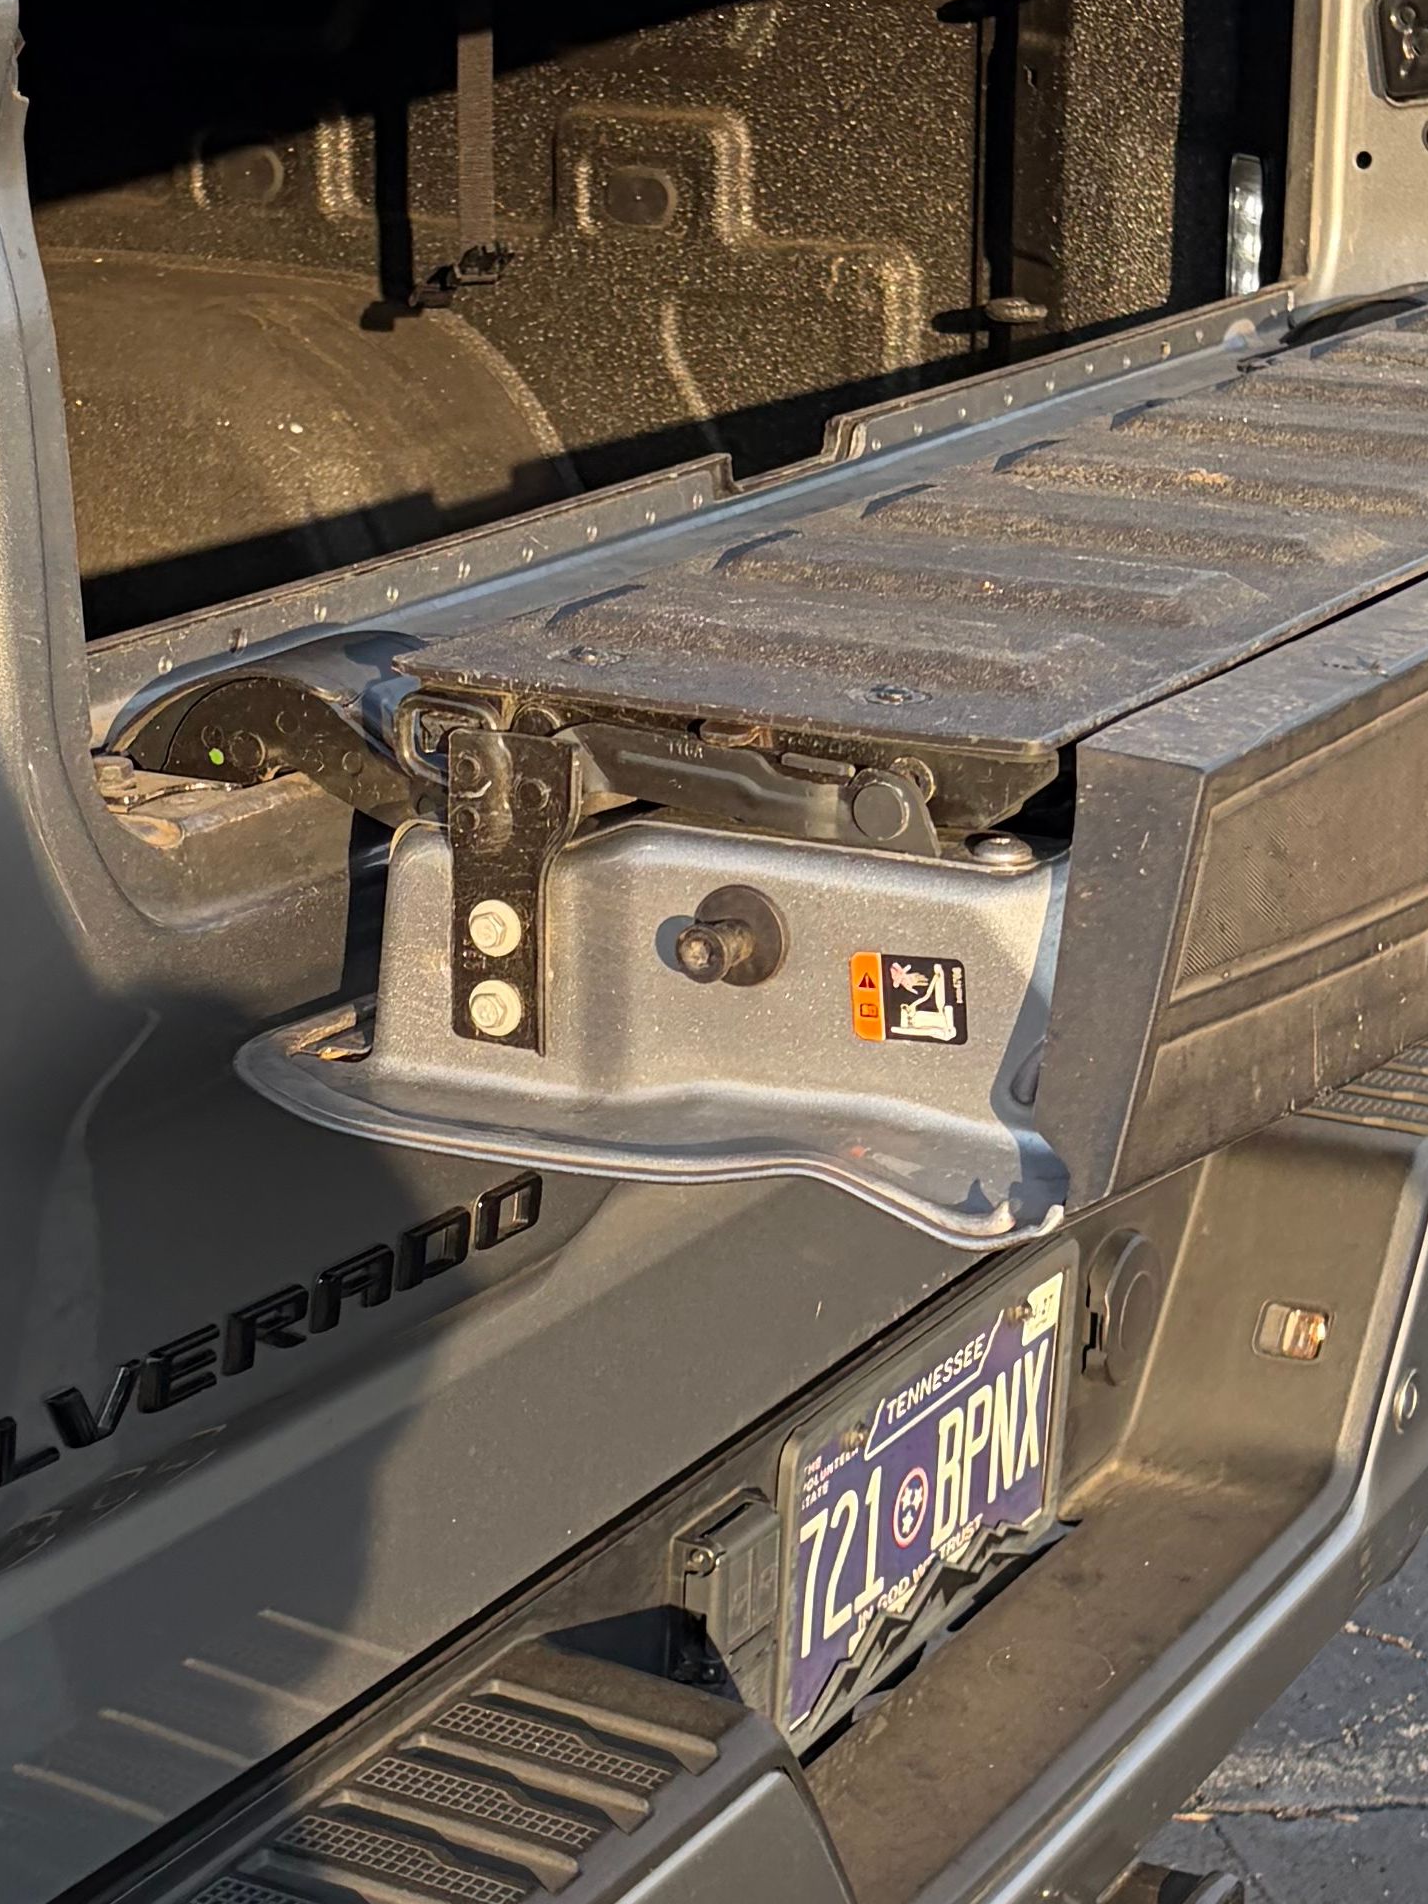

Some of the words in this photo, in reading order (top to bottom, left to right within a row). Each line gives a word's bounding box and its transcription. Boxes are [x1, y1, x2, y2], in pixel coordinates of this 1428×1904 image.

[886, 1332, 986, 1425] TENNESSEE
[799, 1465, 885, 1659] 721
[930, 1338, 1049, 1551] BPNX
[877, 1576, 910, 1609] GOD
[938, 1512, 984, 1560] TRUST
